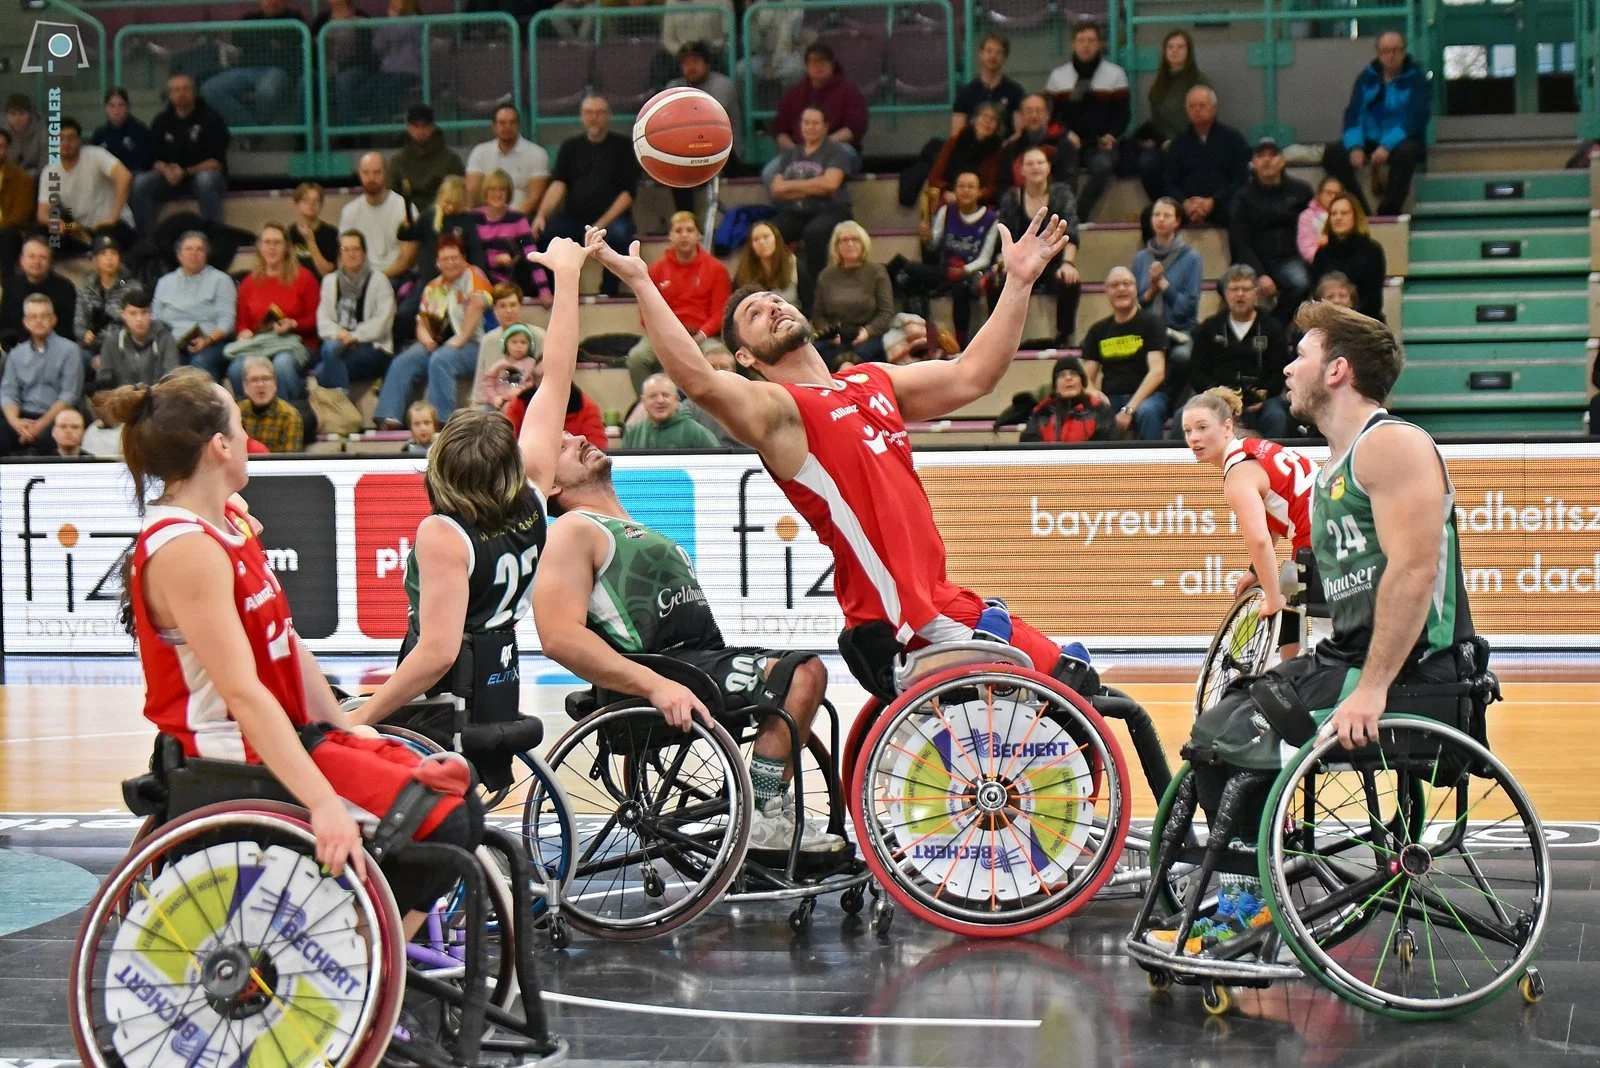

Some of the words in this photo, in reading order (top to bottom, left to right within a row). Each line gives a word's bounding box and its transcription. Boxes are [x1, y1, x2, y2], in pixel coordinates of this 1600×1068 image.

[829, 404, 860, 421] Allianz
[869, 392, 895, 416] 11
[1030, 495, 1218, 547] bayreuths
[1326, 514, 1368, 561] 24
[740, 603, 839, 645] bayre
[991, 741, 1069, 758] BECHERT
[912, 844, 994, 860] BECHERT
[280, 919, 362, 996] BECHERT
[114, 964, 200, 1041] BECHERT
